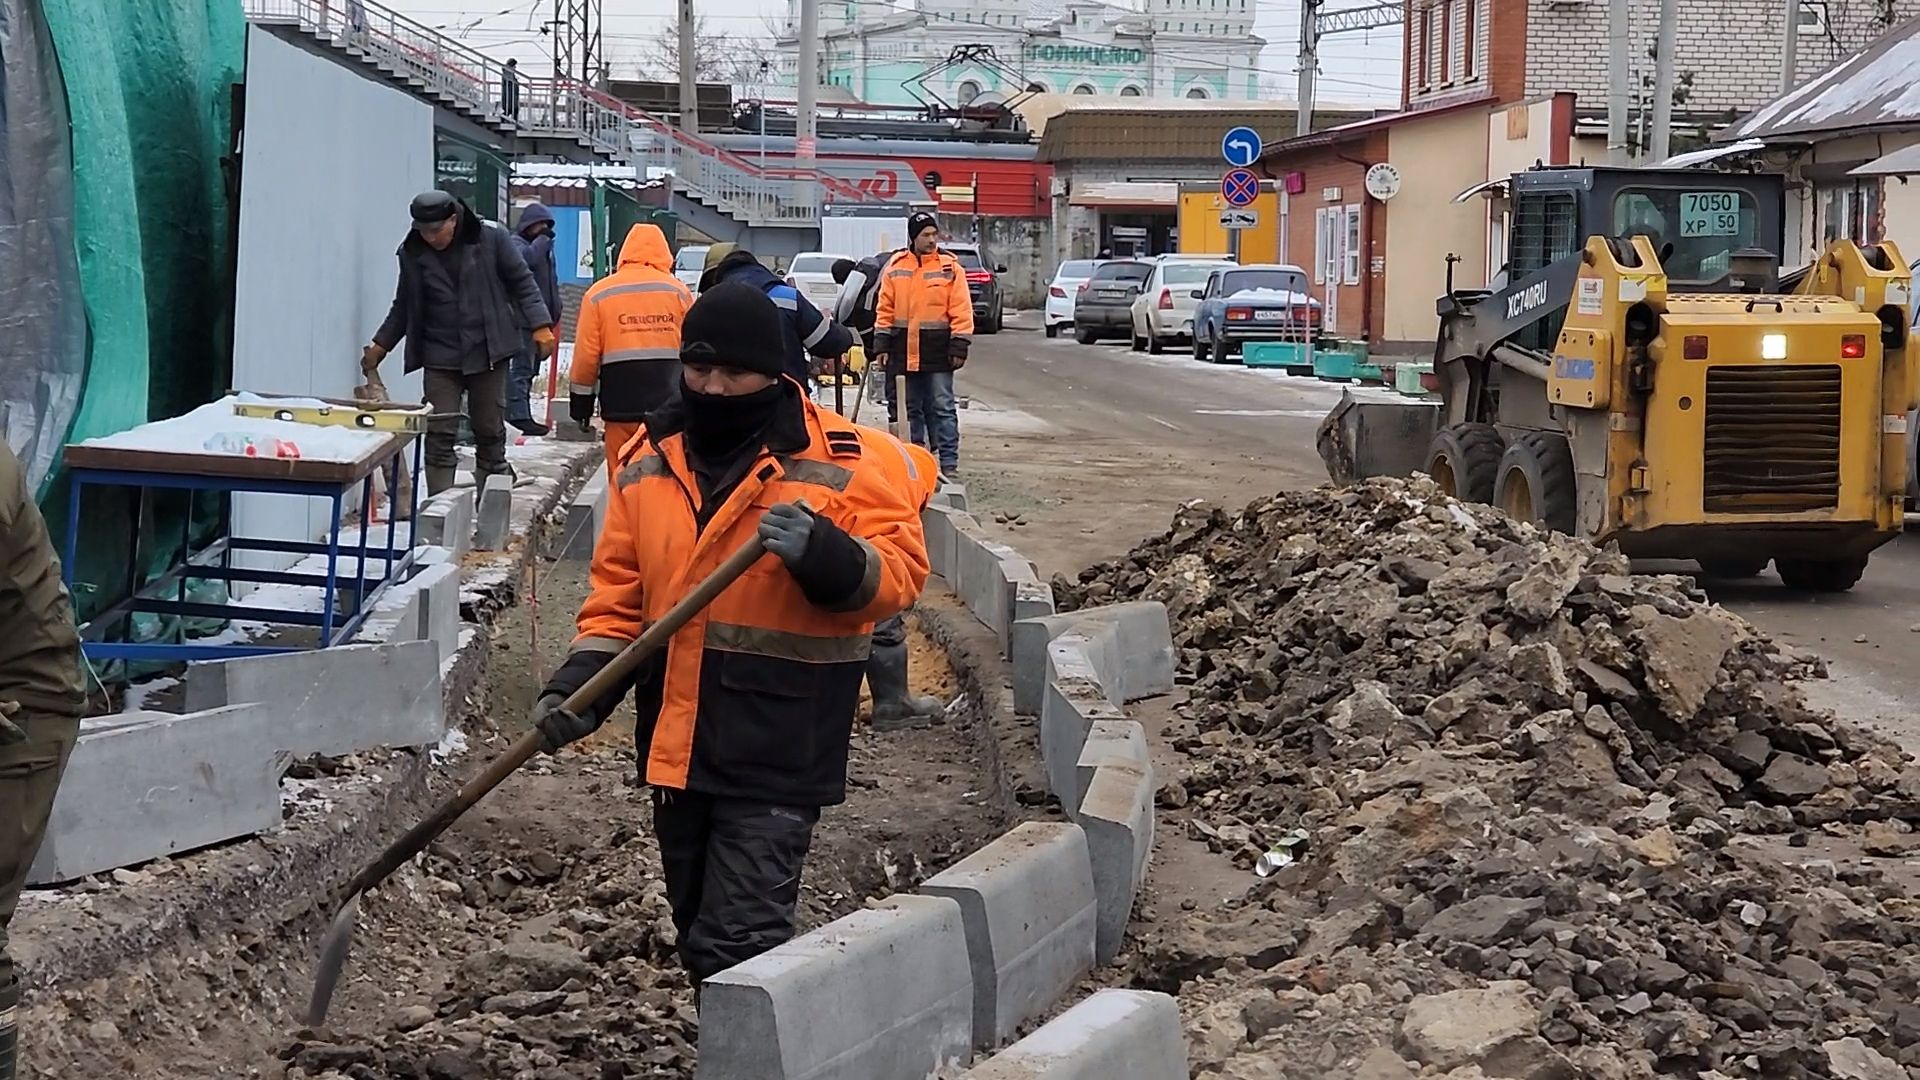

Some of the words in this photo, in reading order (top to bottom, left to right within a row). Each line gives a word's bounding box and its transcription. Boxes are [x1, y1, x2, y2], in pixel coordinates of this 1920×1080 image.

[1688, 194, 1732, 212] 7050
[1718, 215, 1735, 228] 50
[1507, 280, 1547, 319] XC740RU
